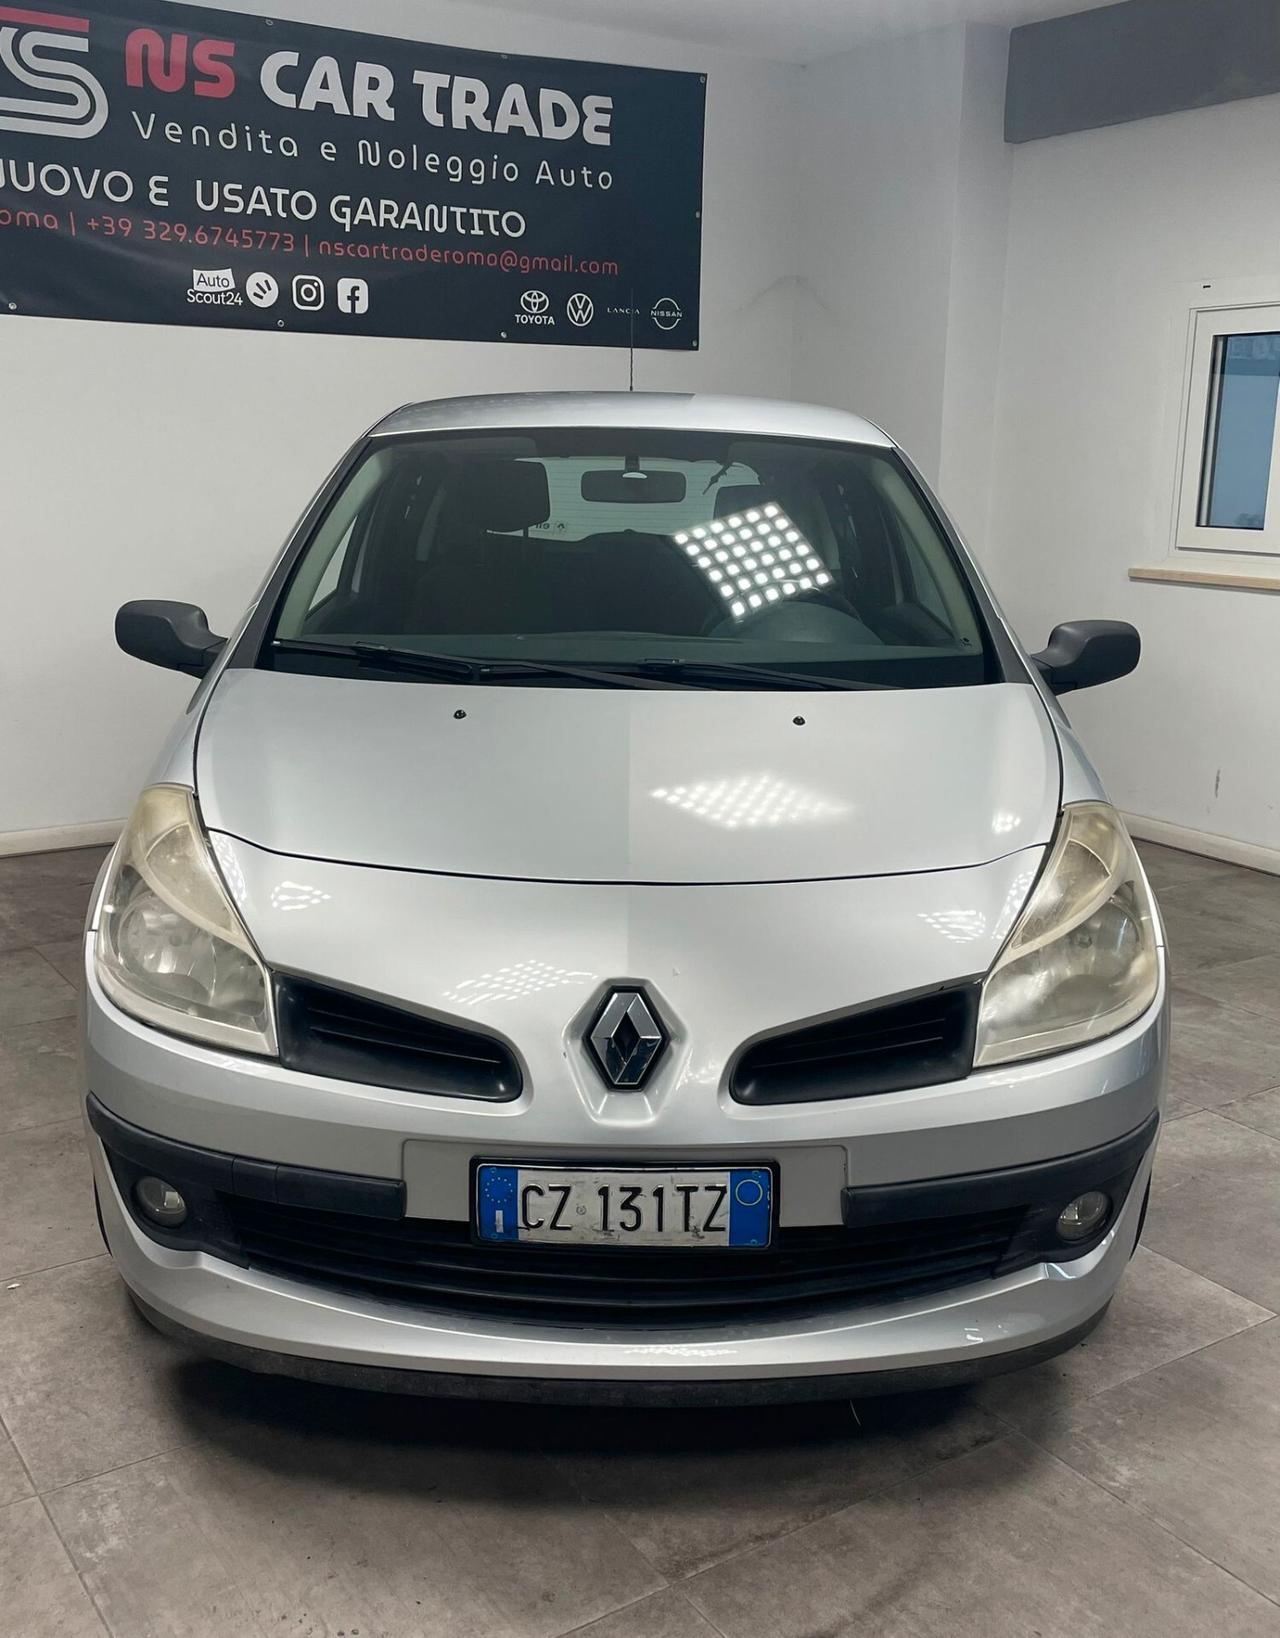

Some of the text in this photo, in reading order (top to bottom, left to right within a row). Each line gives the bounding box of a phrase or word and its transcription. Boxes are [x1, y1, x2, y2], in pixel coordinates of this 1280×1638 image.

[125, 28, 613, 146] NS CAR TRADE
[132, 111, 612, 190] Vendita e Noleggio Auto
[149, 175, 169, 207] E
[195, 179, 317, 221] USATO
[330, 194, 526, 238] GARANTITO
[87, 215, 132, 237] +39
[143, 220, 294, 252] 329.6745773
[319, 240, 618, 276] nscartraderoma@gmail.com
[187, 289, 243, 306] Scout24
[197, 273, 230, 288] Auto
[515, 314, 555, 326] TOYOTA
[651, 310, 683, 318] NISSAN
[521, 1184, 728, 1232] CZ 131TZ
